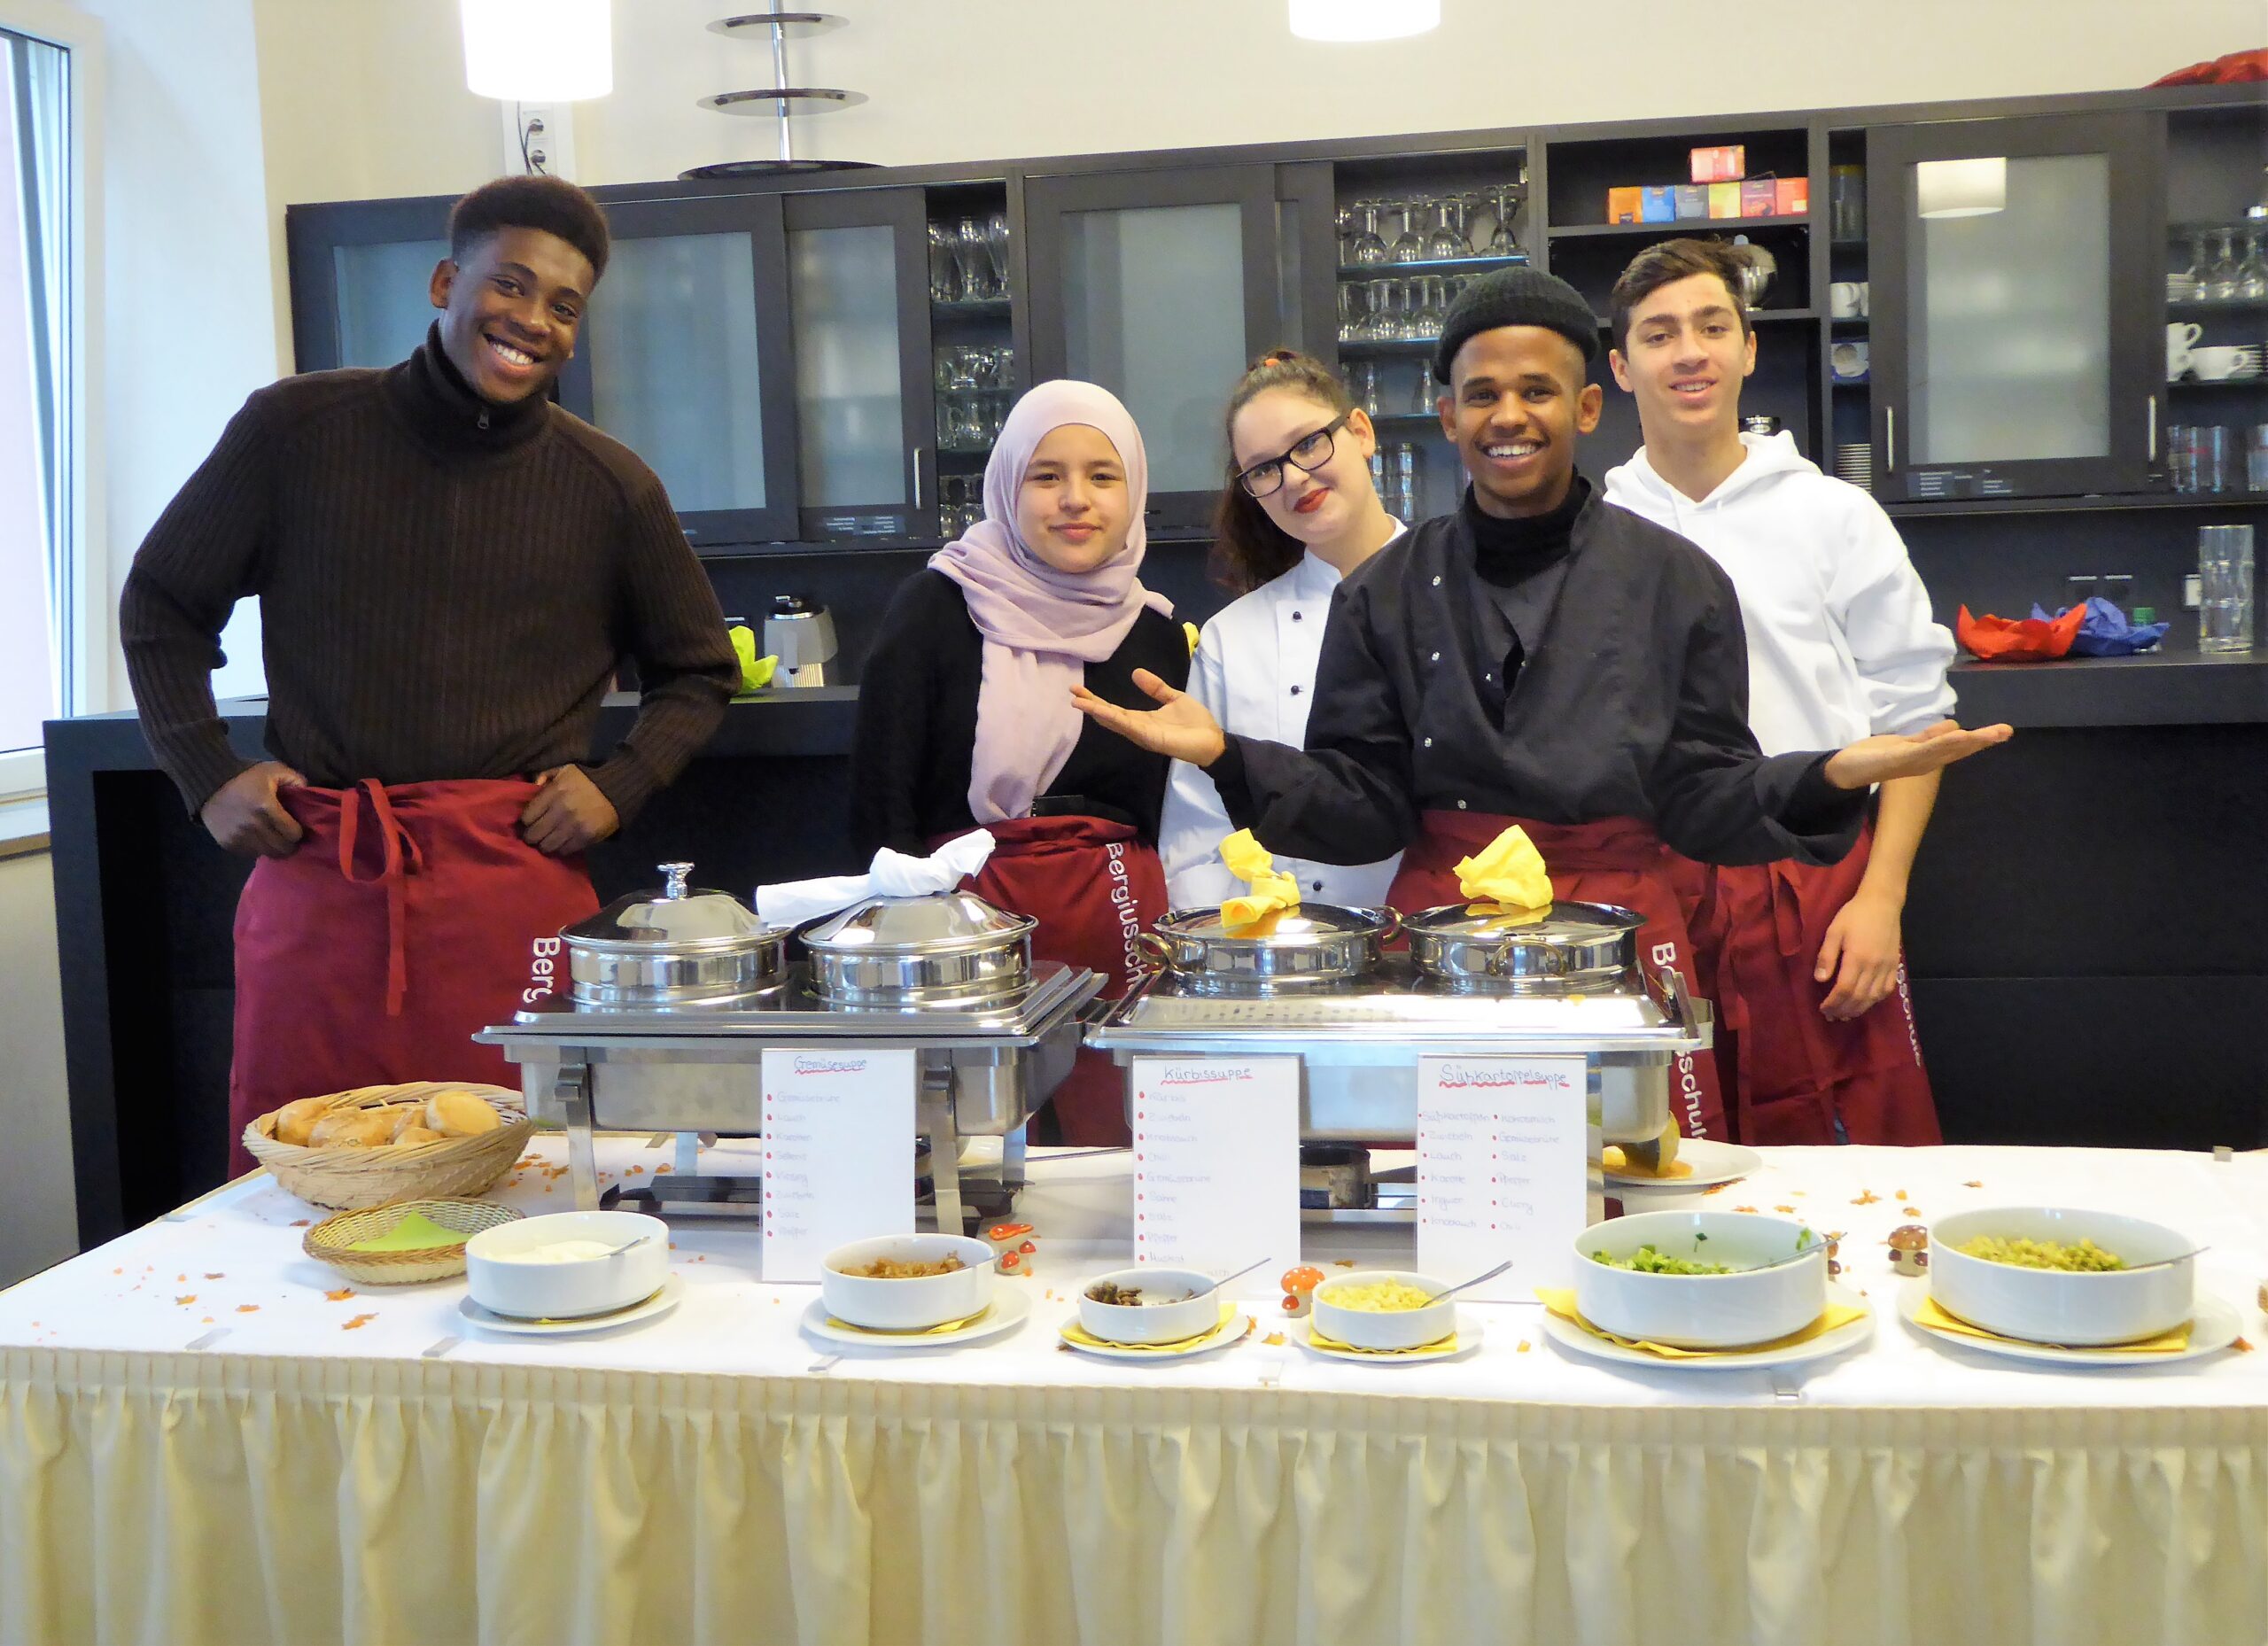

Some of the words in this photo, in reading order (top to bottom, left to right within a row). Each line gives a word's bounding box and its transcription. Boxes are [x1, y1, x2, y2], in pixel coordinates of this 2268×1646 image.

[1106, 842, 1148, 991] Bergiussch
[794, 1055, 867, 1070] Gemüsesuppe
[1163, 1062, 1252, 1081] Kürbissuppe
[1440, 1063, 1566, 1091] Süßkartoffelsuppe
